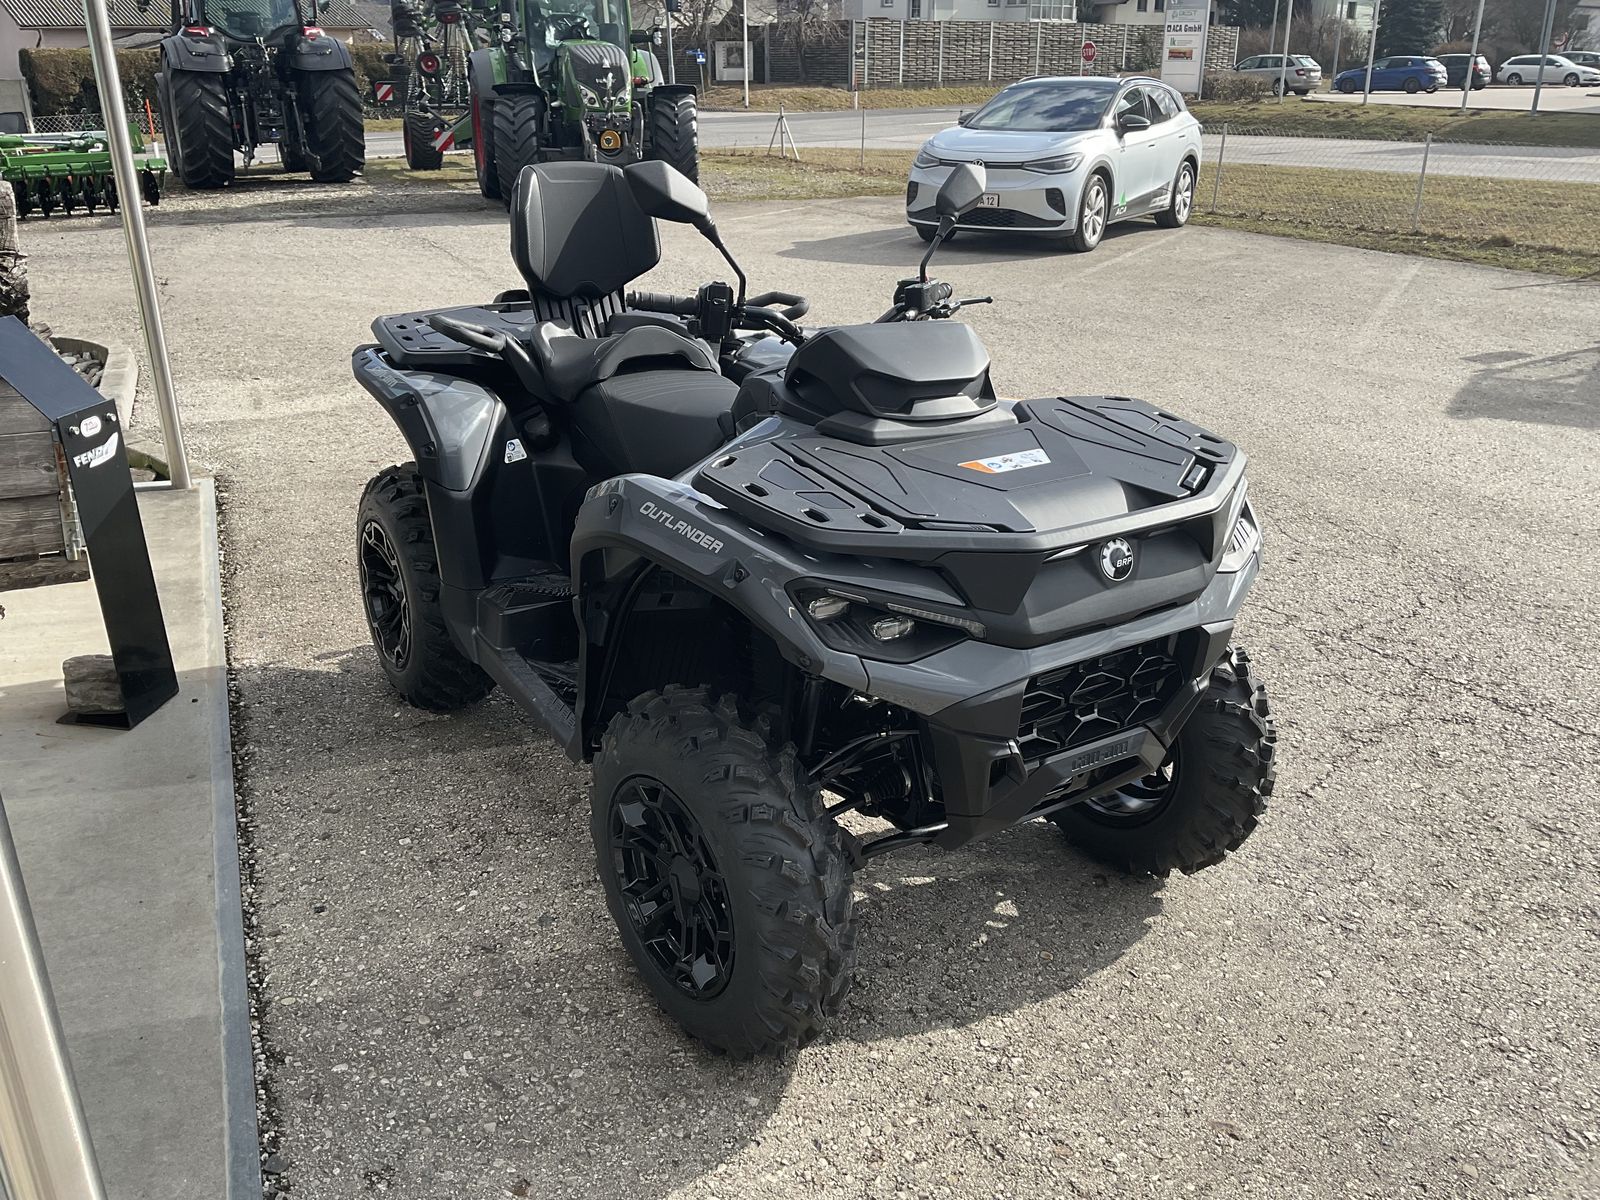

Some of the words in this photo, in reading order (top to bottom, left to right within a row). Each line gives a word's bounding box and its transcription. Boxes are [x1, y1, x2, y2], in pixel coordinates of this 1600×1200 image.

[1171, 24, 1183, 33] ACA
[1184, 24, 1202, 33] GmbH
[1083, 48, 1094, 56] STOP
[986, 196, 995, 206] 12
[639, 501, 724, 554] OUTLANDER
[1116, 556, 1132, 568] BRP
